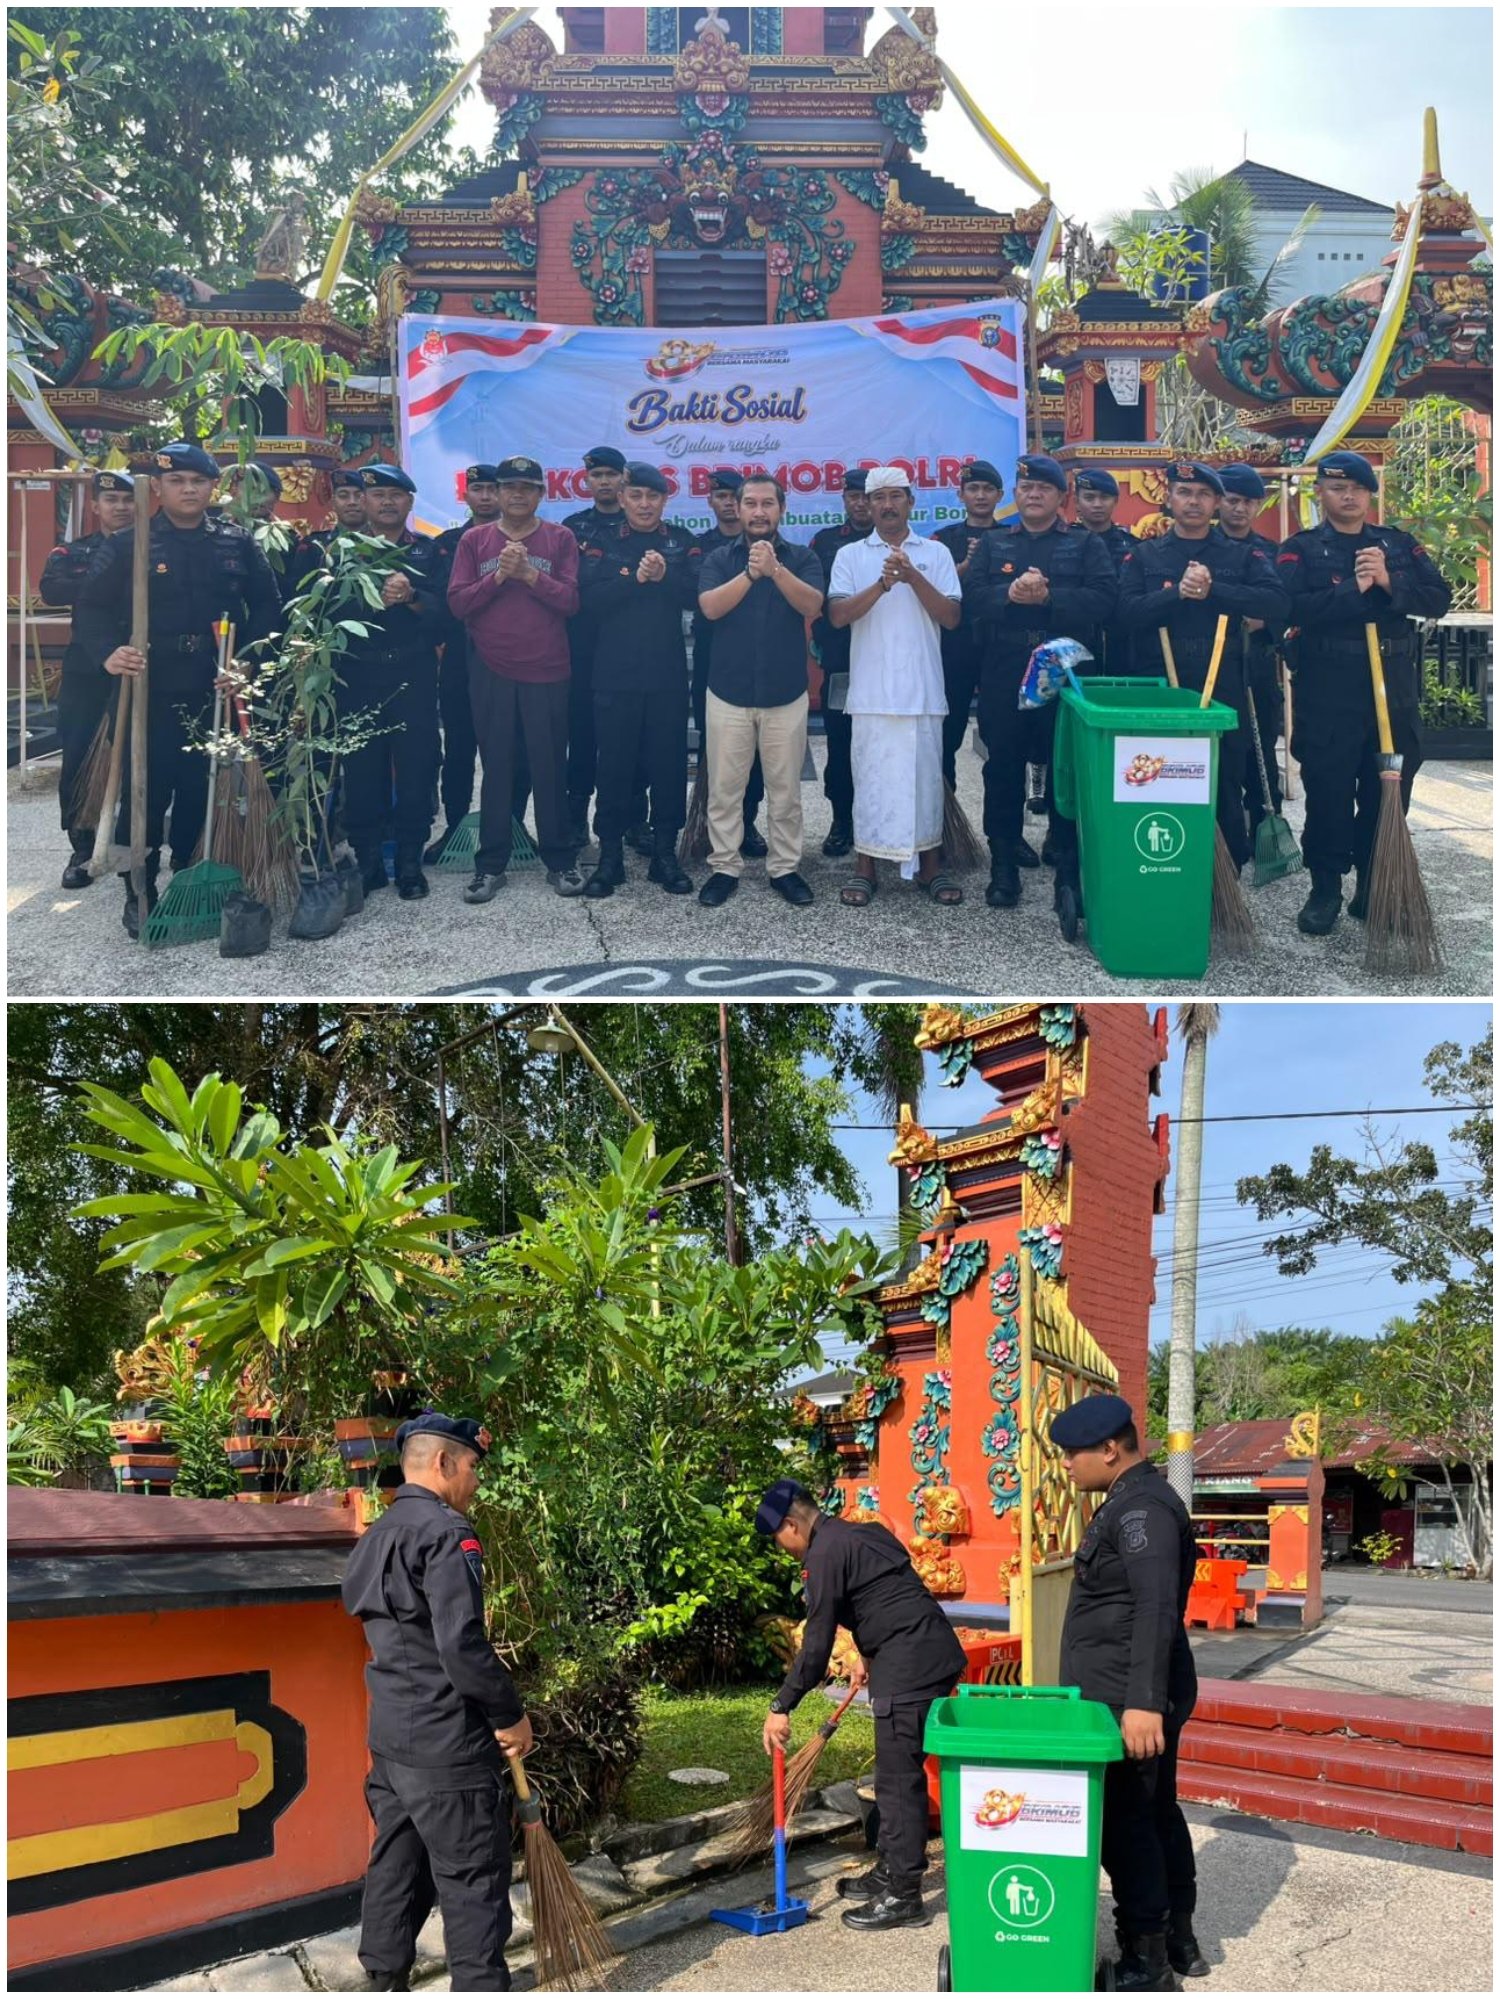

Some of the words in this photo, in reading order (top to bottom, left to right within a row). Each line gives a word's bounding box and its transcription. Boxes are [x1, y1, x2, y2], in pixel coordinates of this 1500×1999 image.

[627, 388, 720, 433] Bakti
[721, 384, 807, 425] Sosial
[654, 433, 725, 459] Dalam
[727, 432, 781, 457] rangka
[1006, 1933, 1019, 1942] GO
